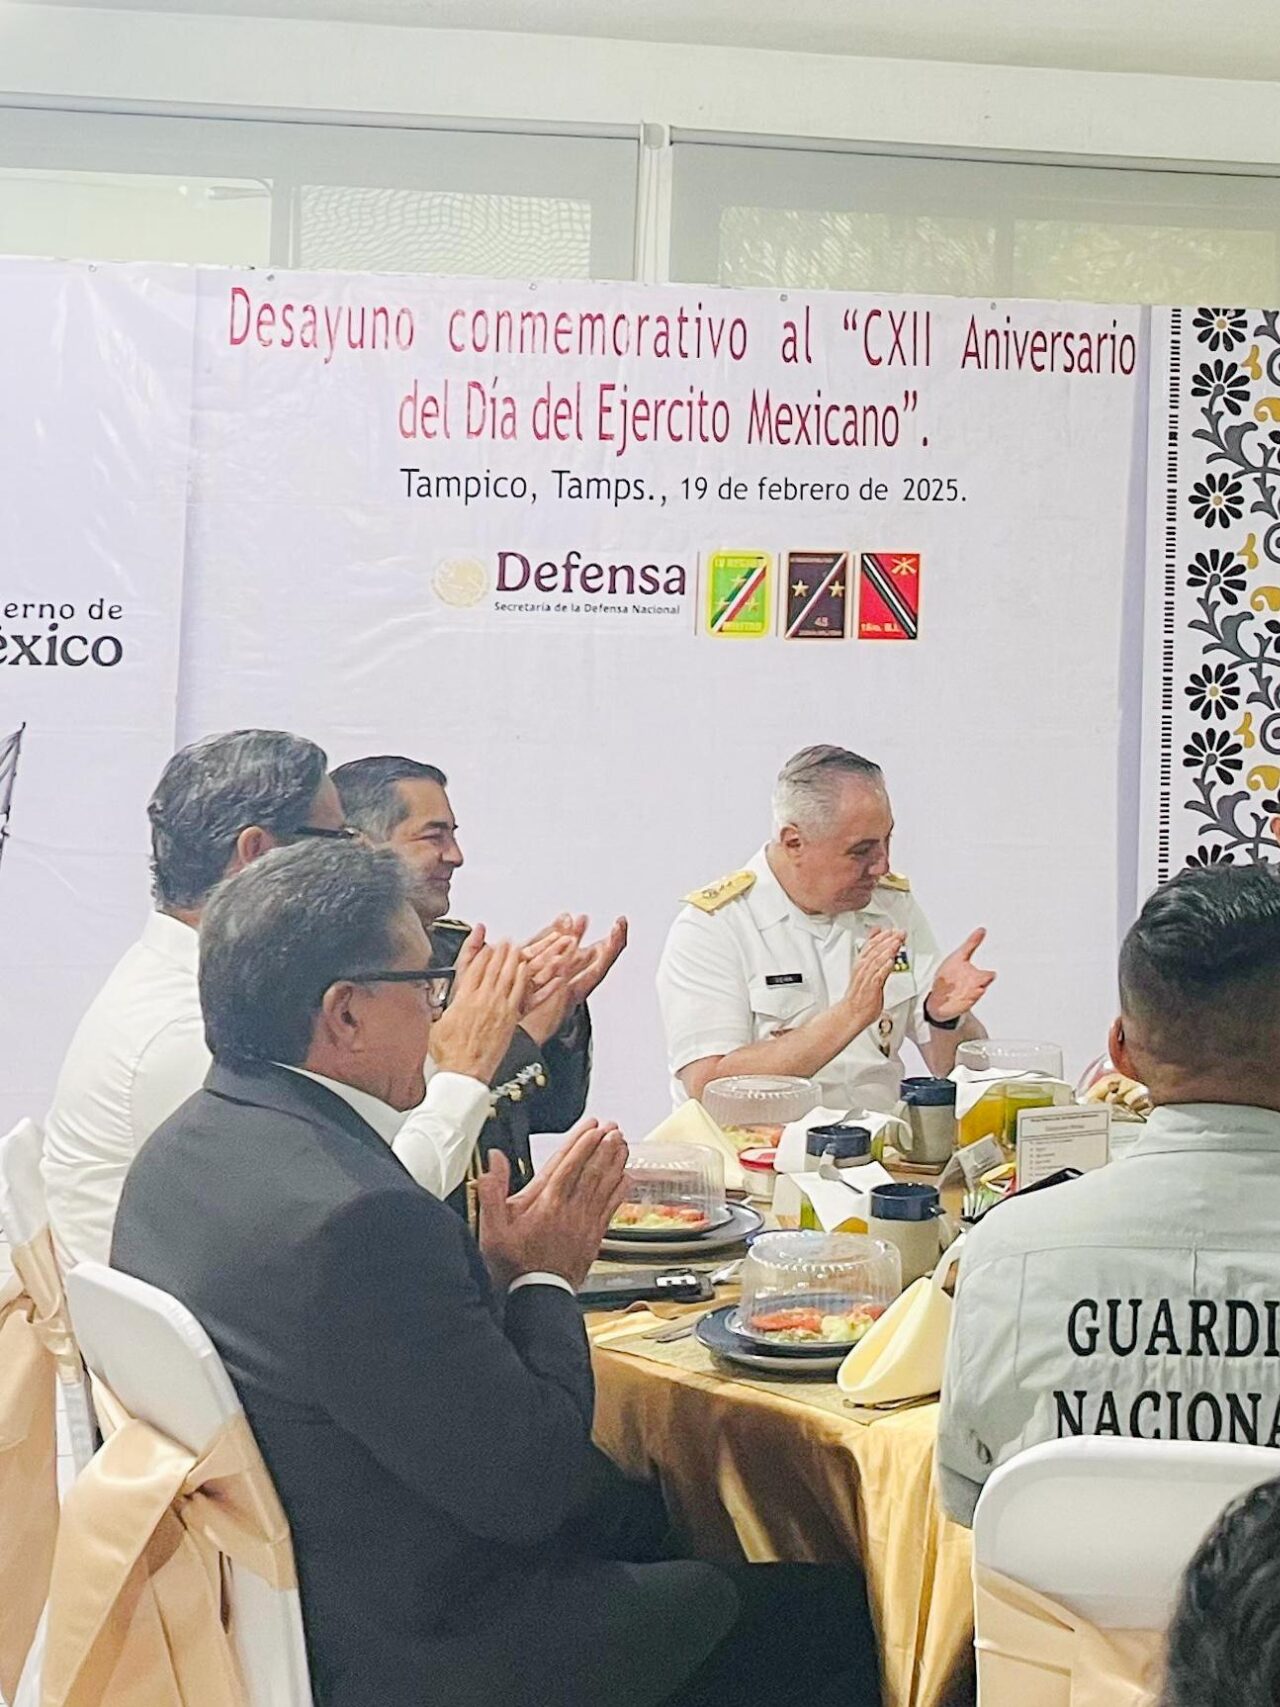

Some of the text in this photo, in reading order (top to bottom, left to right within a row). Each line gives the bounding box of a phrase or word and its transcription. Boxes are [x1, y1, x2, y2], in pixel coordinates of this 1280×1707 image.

[229, 286, 1137, 376] Desayuno conmemorativo al “CXII Aniversario
[399, 376, 930, 458] del Día del Ejercito Mexicano”.
[400, 467, 968, 508] Tampico, Tamps., 19 de febrero de 2025.
[495, 550, 687, 596] Defensa
[3, 597, 123, 620] erno de
[494, 601, 681, 615] Secretaría de la Defensa Nacional
